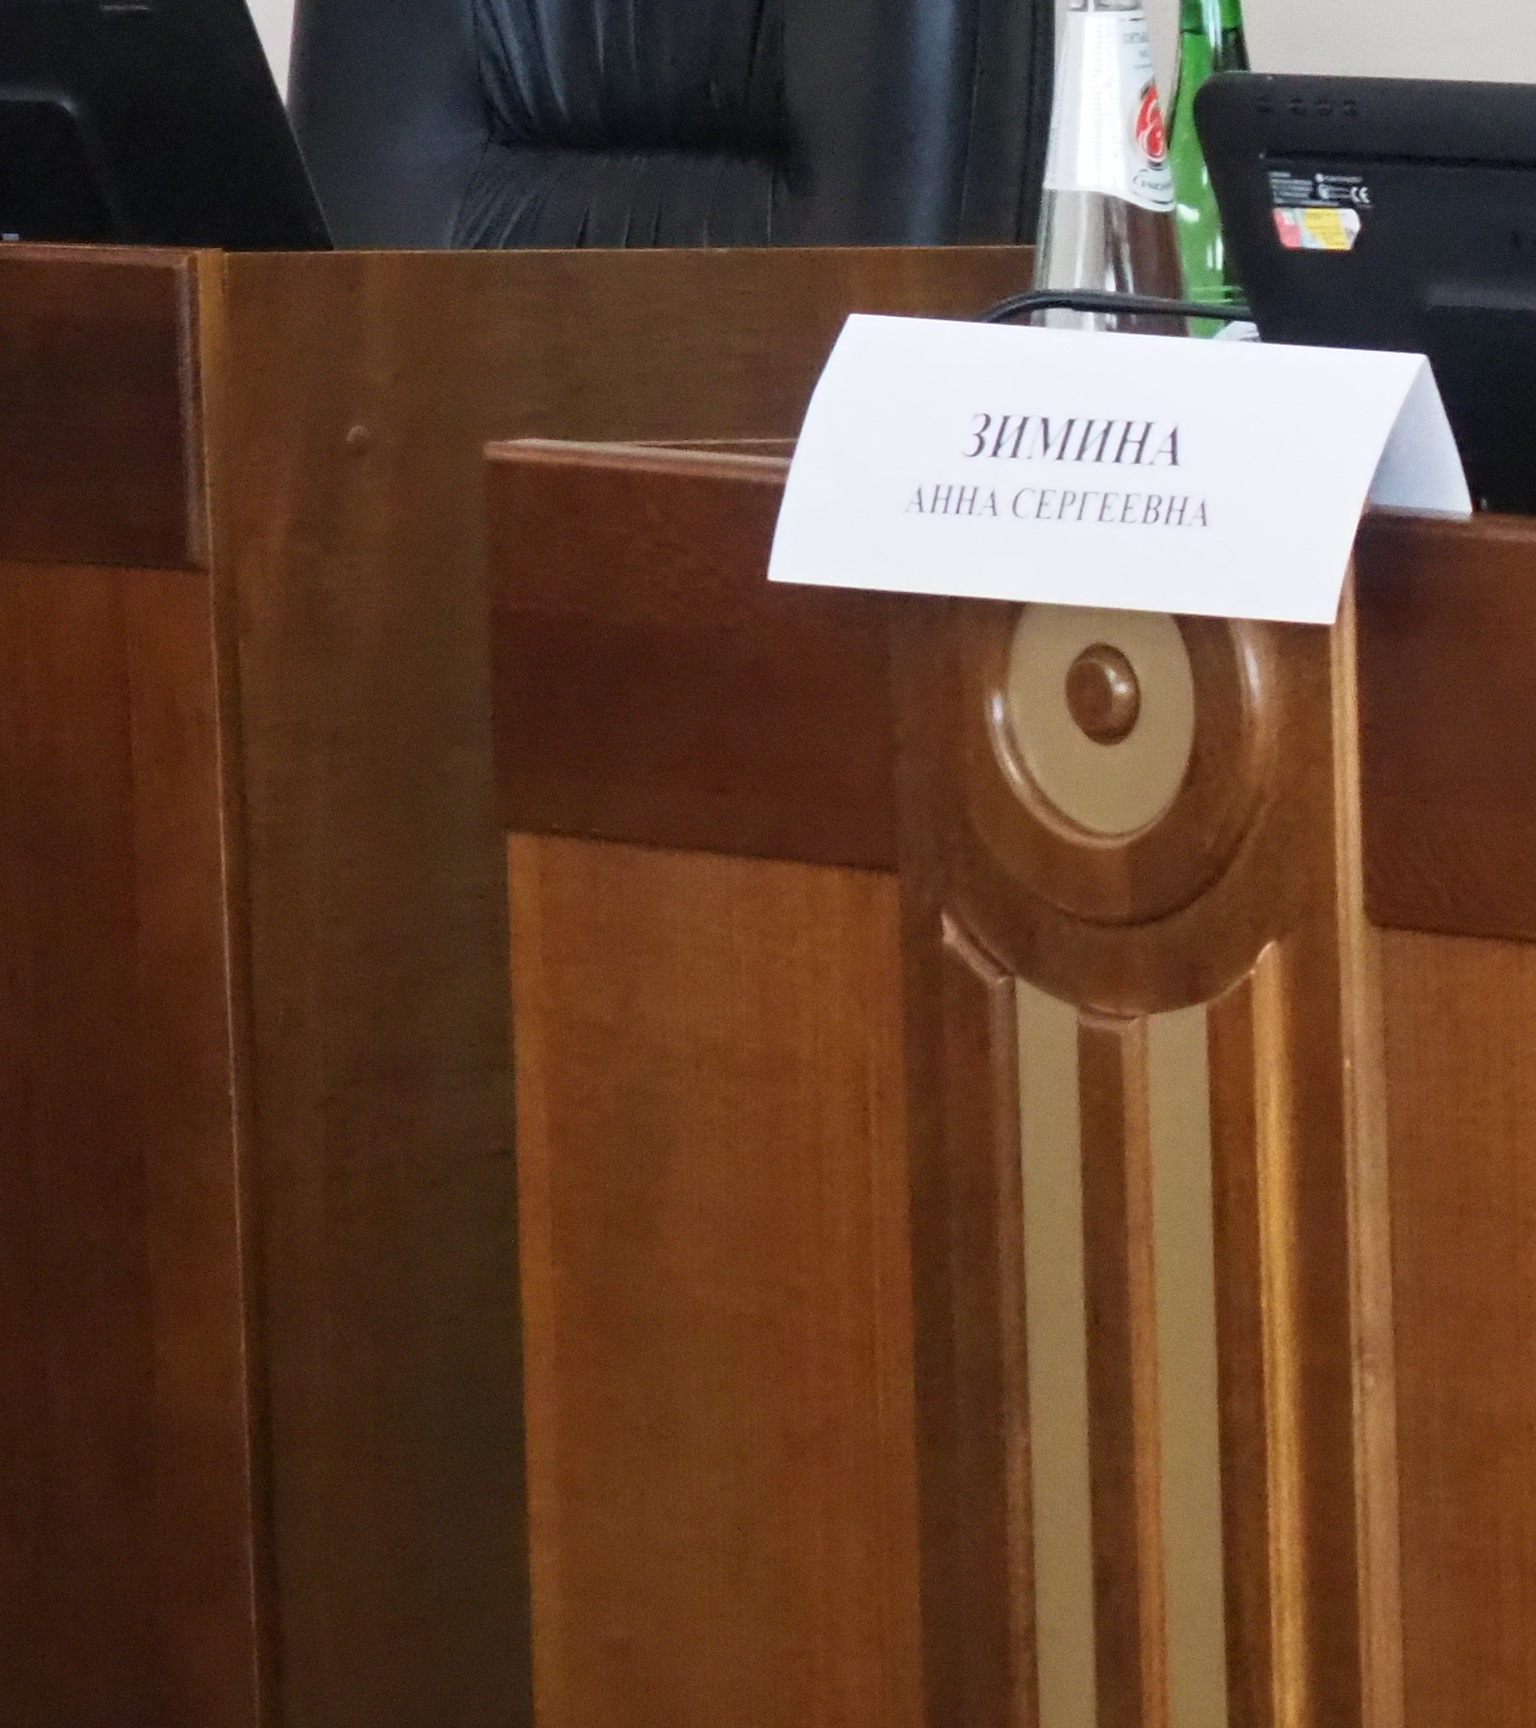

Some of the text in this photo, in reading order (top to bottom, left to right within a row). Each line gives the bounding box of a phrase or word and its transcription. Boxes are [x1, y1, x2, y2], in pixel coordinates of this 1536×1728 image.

[962, 412, 1181, 467] ЗИМИНА
[905, 484, 1210, 528] АННА СЕРГЕЕВНА
